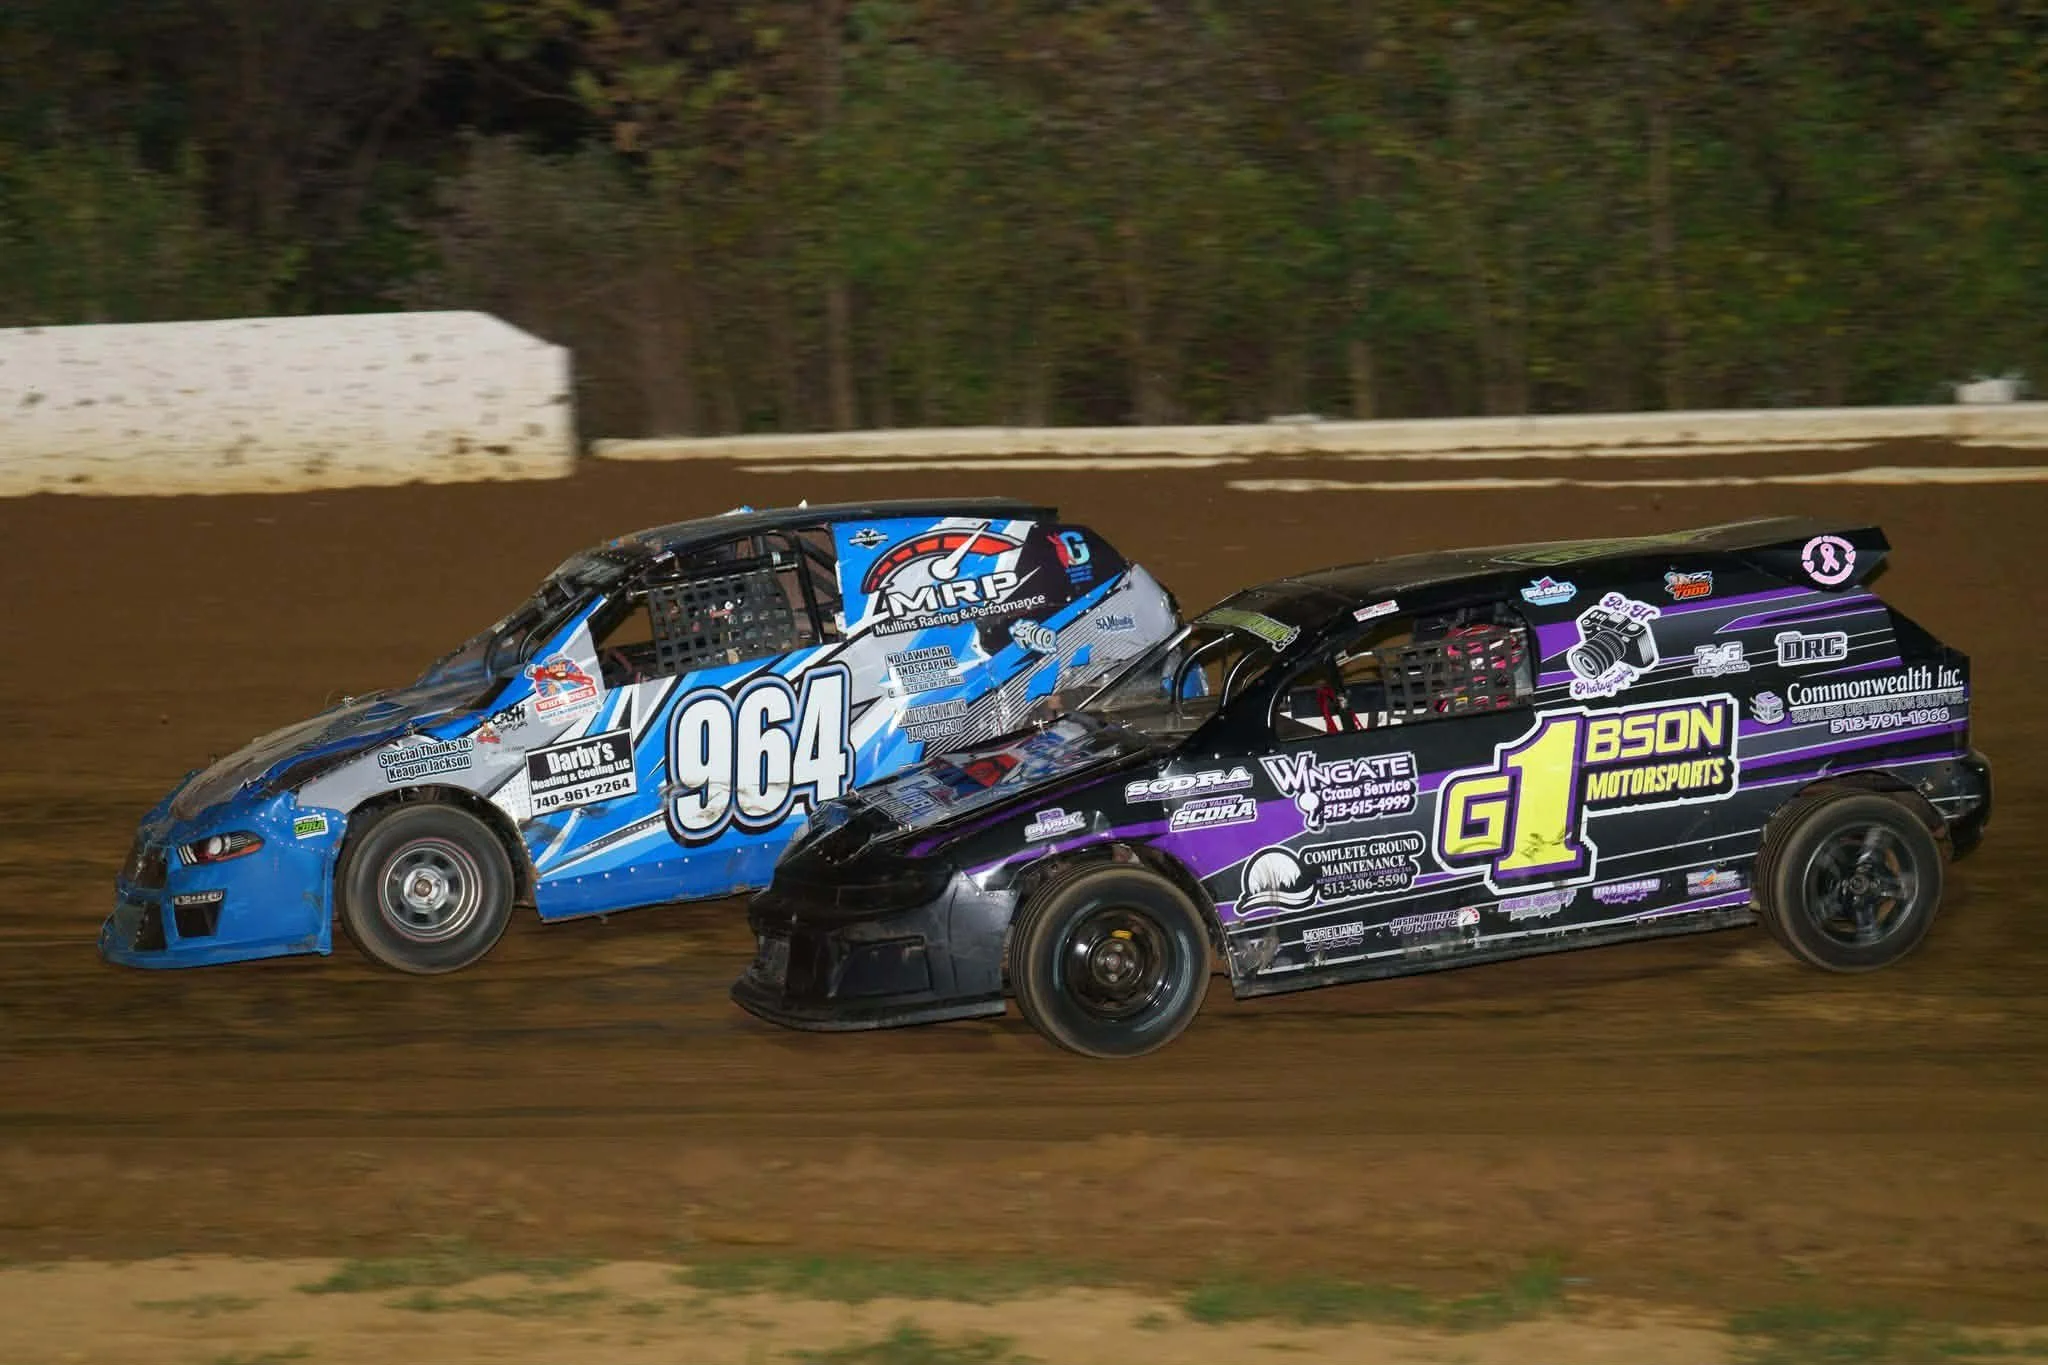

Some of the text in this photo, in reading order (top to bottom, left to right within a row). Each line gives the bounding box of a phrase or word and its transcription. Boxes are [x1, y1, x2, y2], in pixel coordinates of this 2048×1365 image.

[889, 571, 1018, 617] MRP
[1524, 584, 1573, 600] BIG DEAL
[874, 616, 918, 636] Mullins
[920, 610, 960, 629] Racing
[971, 594, 1047, 618] Performance
[903, 649, 930, 662] LAWN
[932, 646, 951, 657] AND
[1784, 635, 1843, 661] DRC
[893, 657, 957, 677] ANDSCAPING
[1573, 663, 1635, 696] Photography
[1787, 664, 1964, 705] Commonwealth Inc.
[1791, 704, 1845, 724] SEAMLESS
[1848, 698, 1915, 717] DISTRIBUTION
[1830, 707, 1950, 735] 513-791-1966
[381, 748, 419, 766] Special
[420, 742, 457, 757] Thanks
[458, 738, 472, 749] to:
[546, 741, 615, 775] Darby's
[677, 674, 847, 830] 964
[389, 755, 470, 780] Keagan Jackson
[531, 758, 631, 791] Heating & Cooling LLC
[1266, 755, 1411, 793] WINGATE
[1585, 756, 1725, 802] MOTORSPORTS
[534, 777, 631, 809] 740-961-2264
[1127, 768, 1251, 797] SCDRA
[1321, 778, 1411, 803] Crane Service
[1174, 801, 1253, 826] SCDRA
[1208, 797, 1238, 807] VALLEY
[1323, 794, 1411, 820] 513-615-4999
[1303, 838, 1420, 865] COMPLETE GROUND
[1321, 854, 1407, 878] MAINTENANCE
[1323, 872, 1408, 896] 513-306-5590
[1593, 878, 1661, 899] BRADSHAW
[1390, 910, 1460, 928] JASON WATERS
[1390, 920, 1458, 936] TUNING
[1304, 922, 1363, 943] MORELAND
